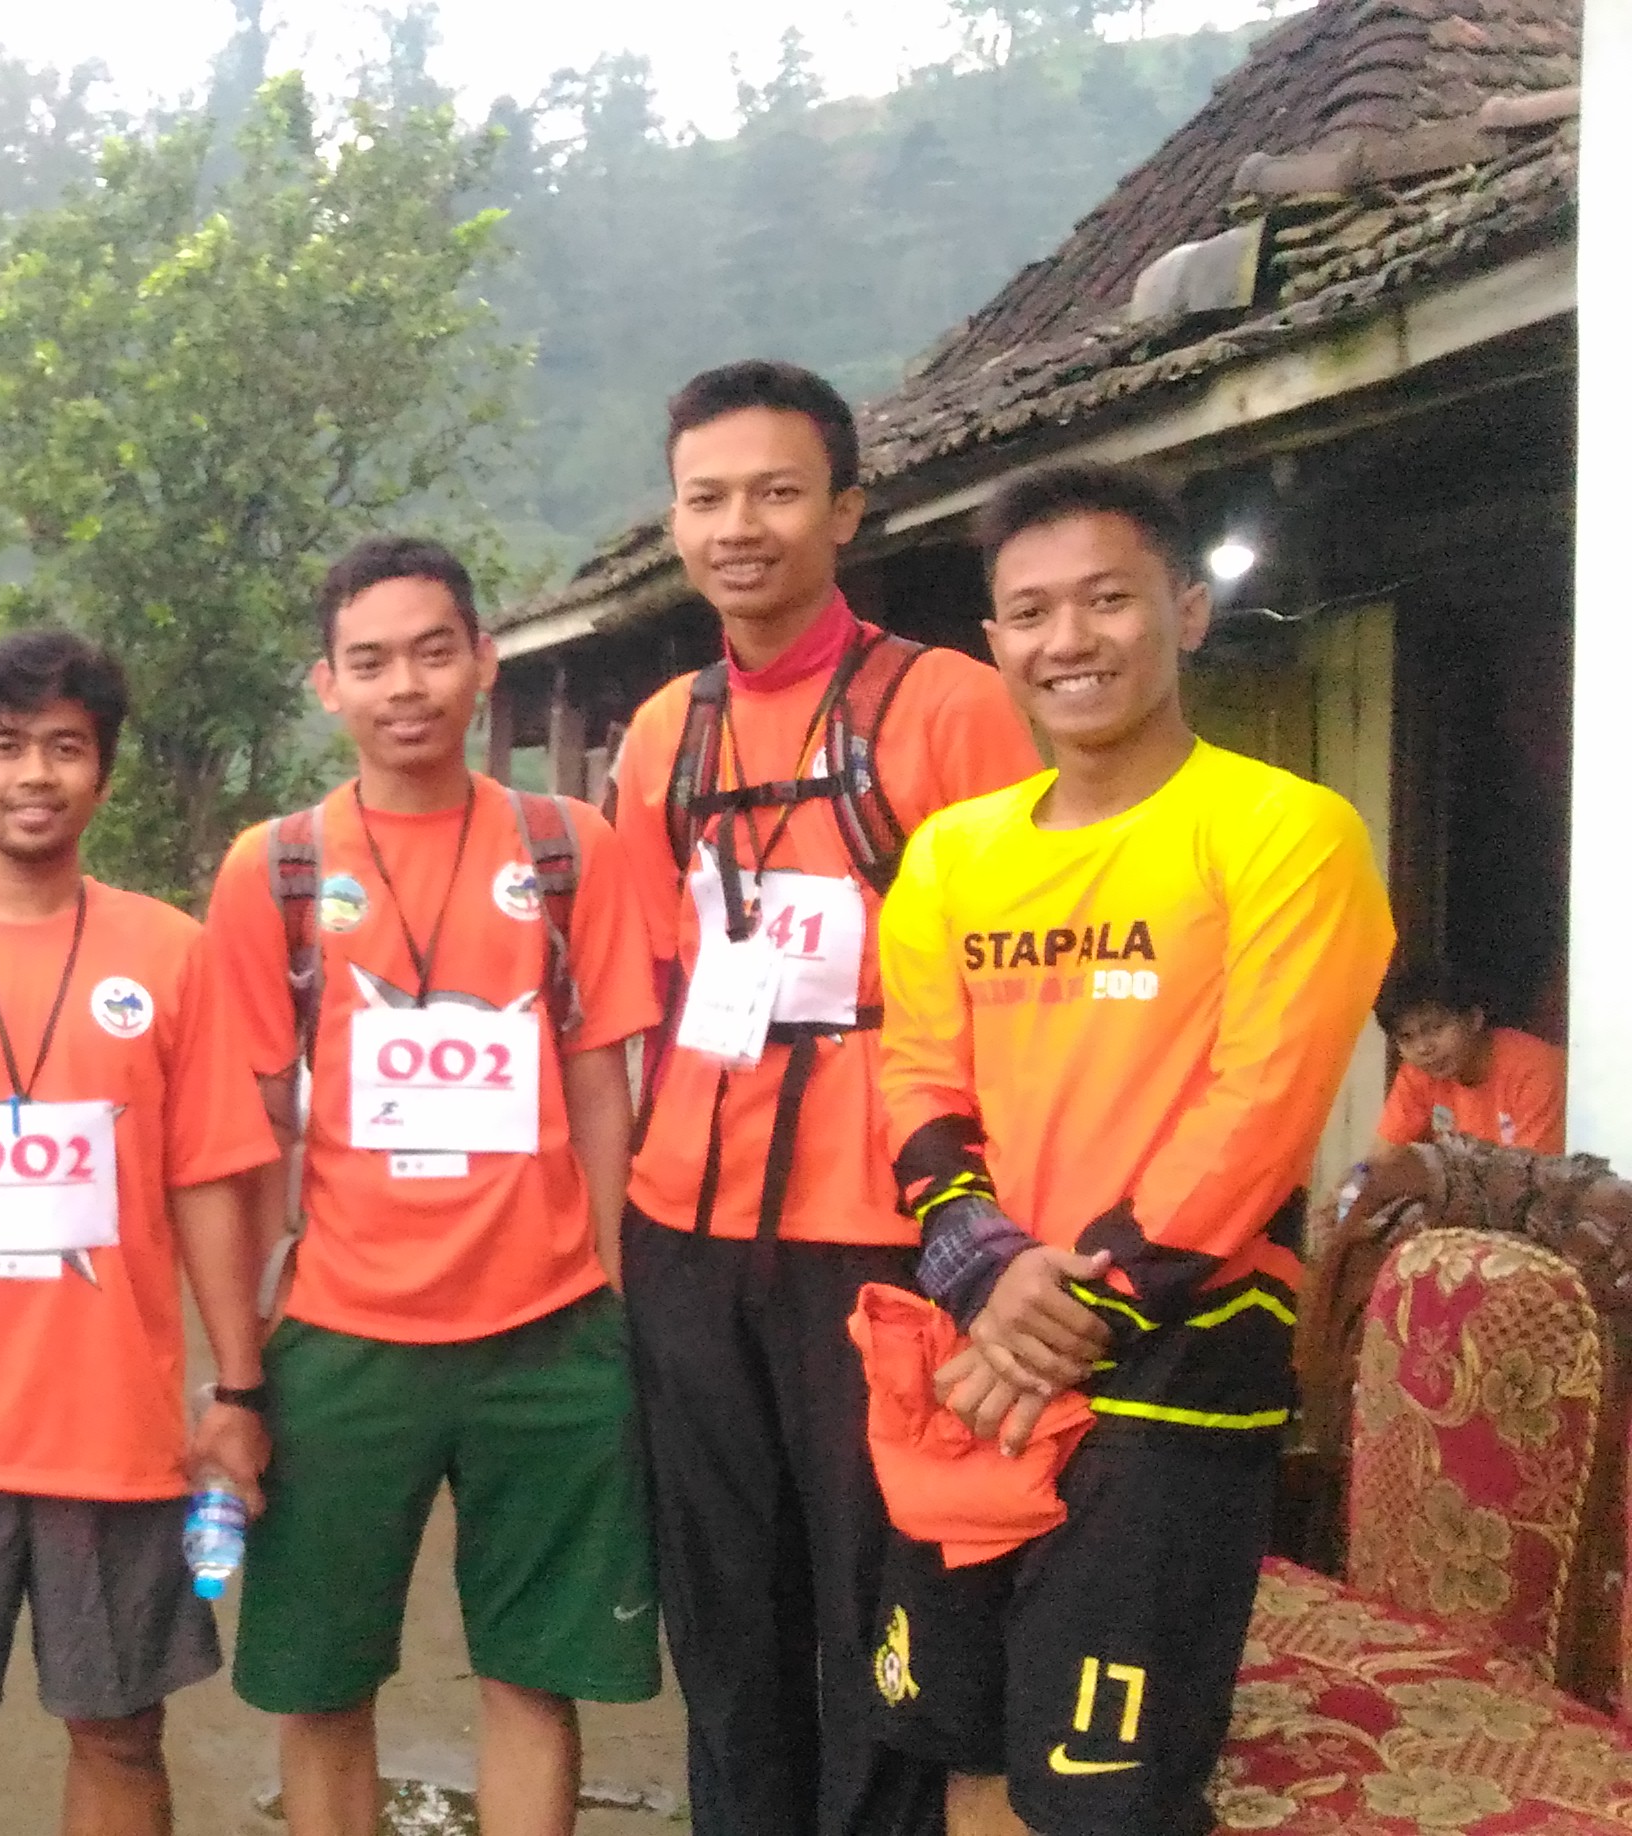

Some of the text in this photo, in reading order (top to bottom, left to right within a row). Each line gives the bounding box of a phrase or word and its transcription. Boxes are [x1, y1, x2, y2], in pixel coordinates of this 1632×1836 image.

[756, 905, 823, 953] 41
[964, 920, 1156, 970] STAPALA
[377, 1038, 513, 1083] 002
[1073, 1656, 1146, 1743] 17
